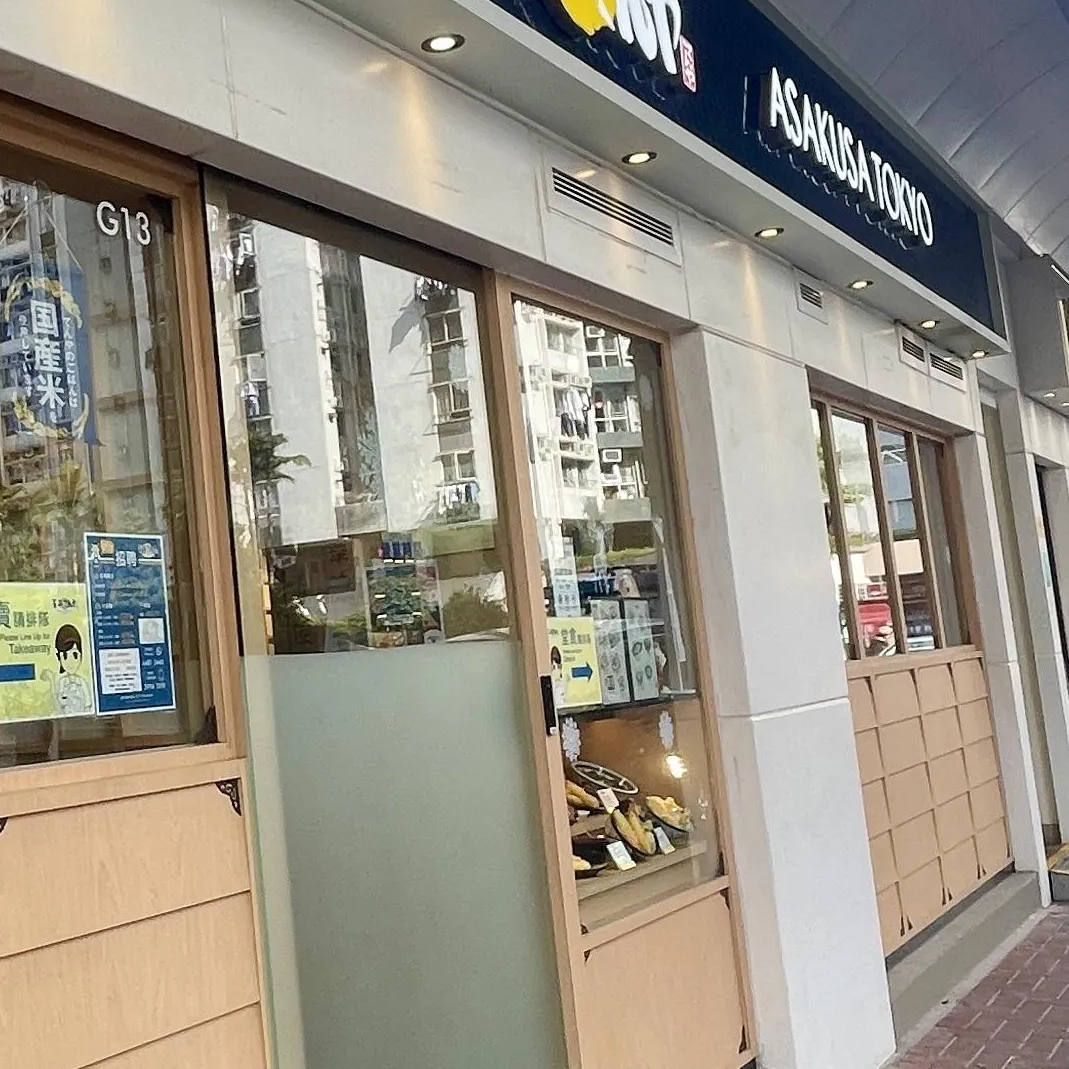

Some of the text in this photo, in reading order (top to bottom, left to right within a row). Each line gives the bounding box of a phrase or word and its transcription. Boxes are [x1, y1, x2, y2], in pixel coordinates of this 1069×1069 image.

[770, 66, 933, 246] ASAKUSA TOKYO
[96, 200, 151, 246] G13
[29, 299, 65, 410] 国産米
[8, 643, 52, 656] Takeaway
